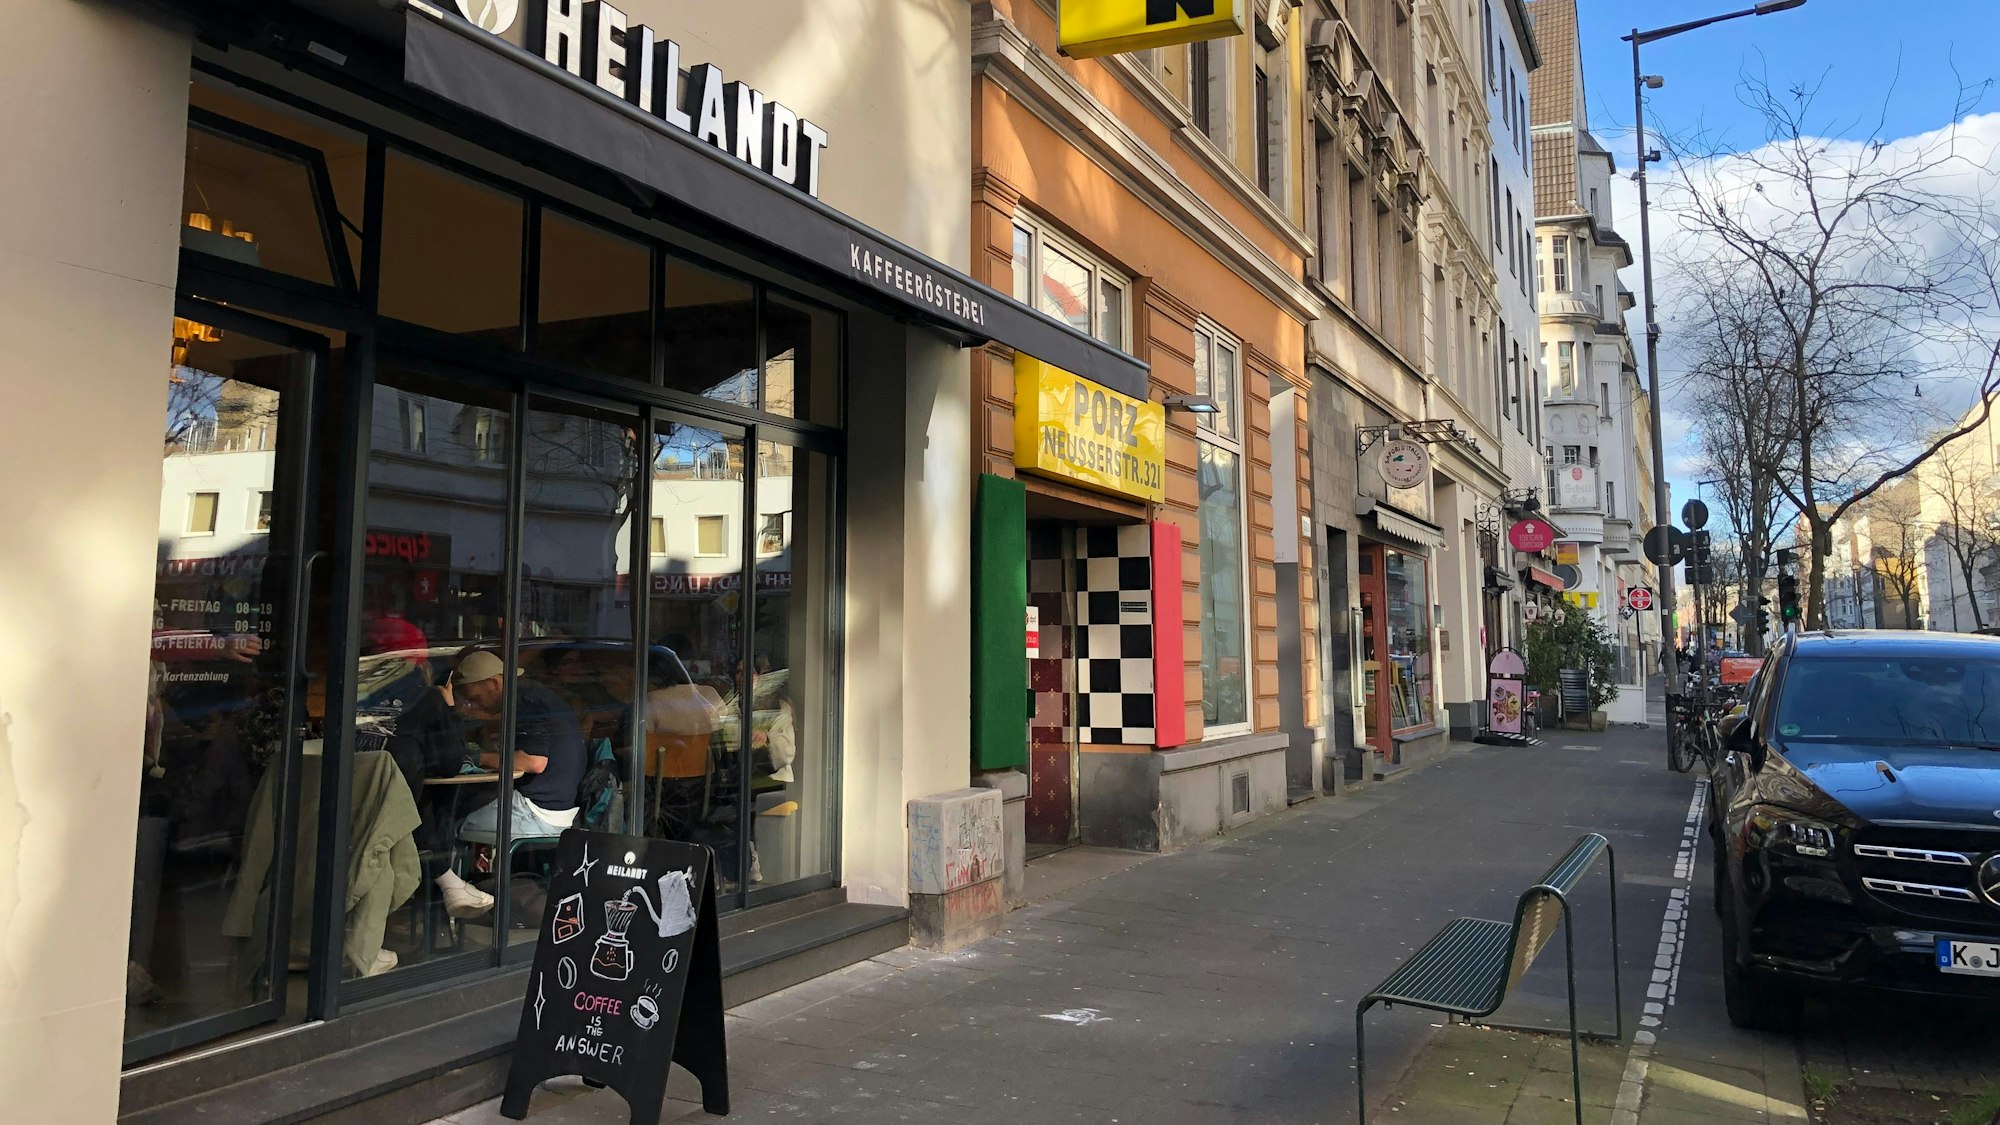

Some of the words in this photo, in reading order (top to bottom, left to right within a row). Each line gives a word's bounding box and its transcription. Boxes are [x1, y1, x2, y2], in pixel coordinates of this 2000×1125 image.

[543, 0, 828, 199] HEILANDT
[850, 242, 985, 326] KAFFEERÖSTEREI
[1074, 380, 1138, 448] PORZ
[171, 599, 220, 613] FREITAG
[169, 638, 226, 650] FEIERTAG
[164, 672, 229, 683] Kartenzahlung
[606, 865, 648, 880] HEILANDT
[573, 991, 623, 1016] COFFEE
[590, 1015, 602, 1027] IS
[585, 1025, 604, 1037] THE
[554, 1034, 625, 1065] ANSWER
